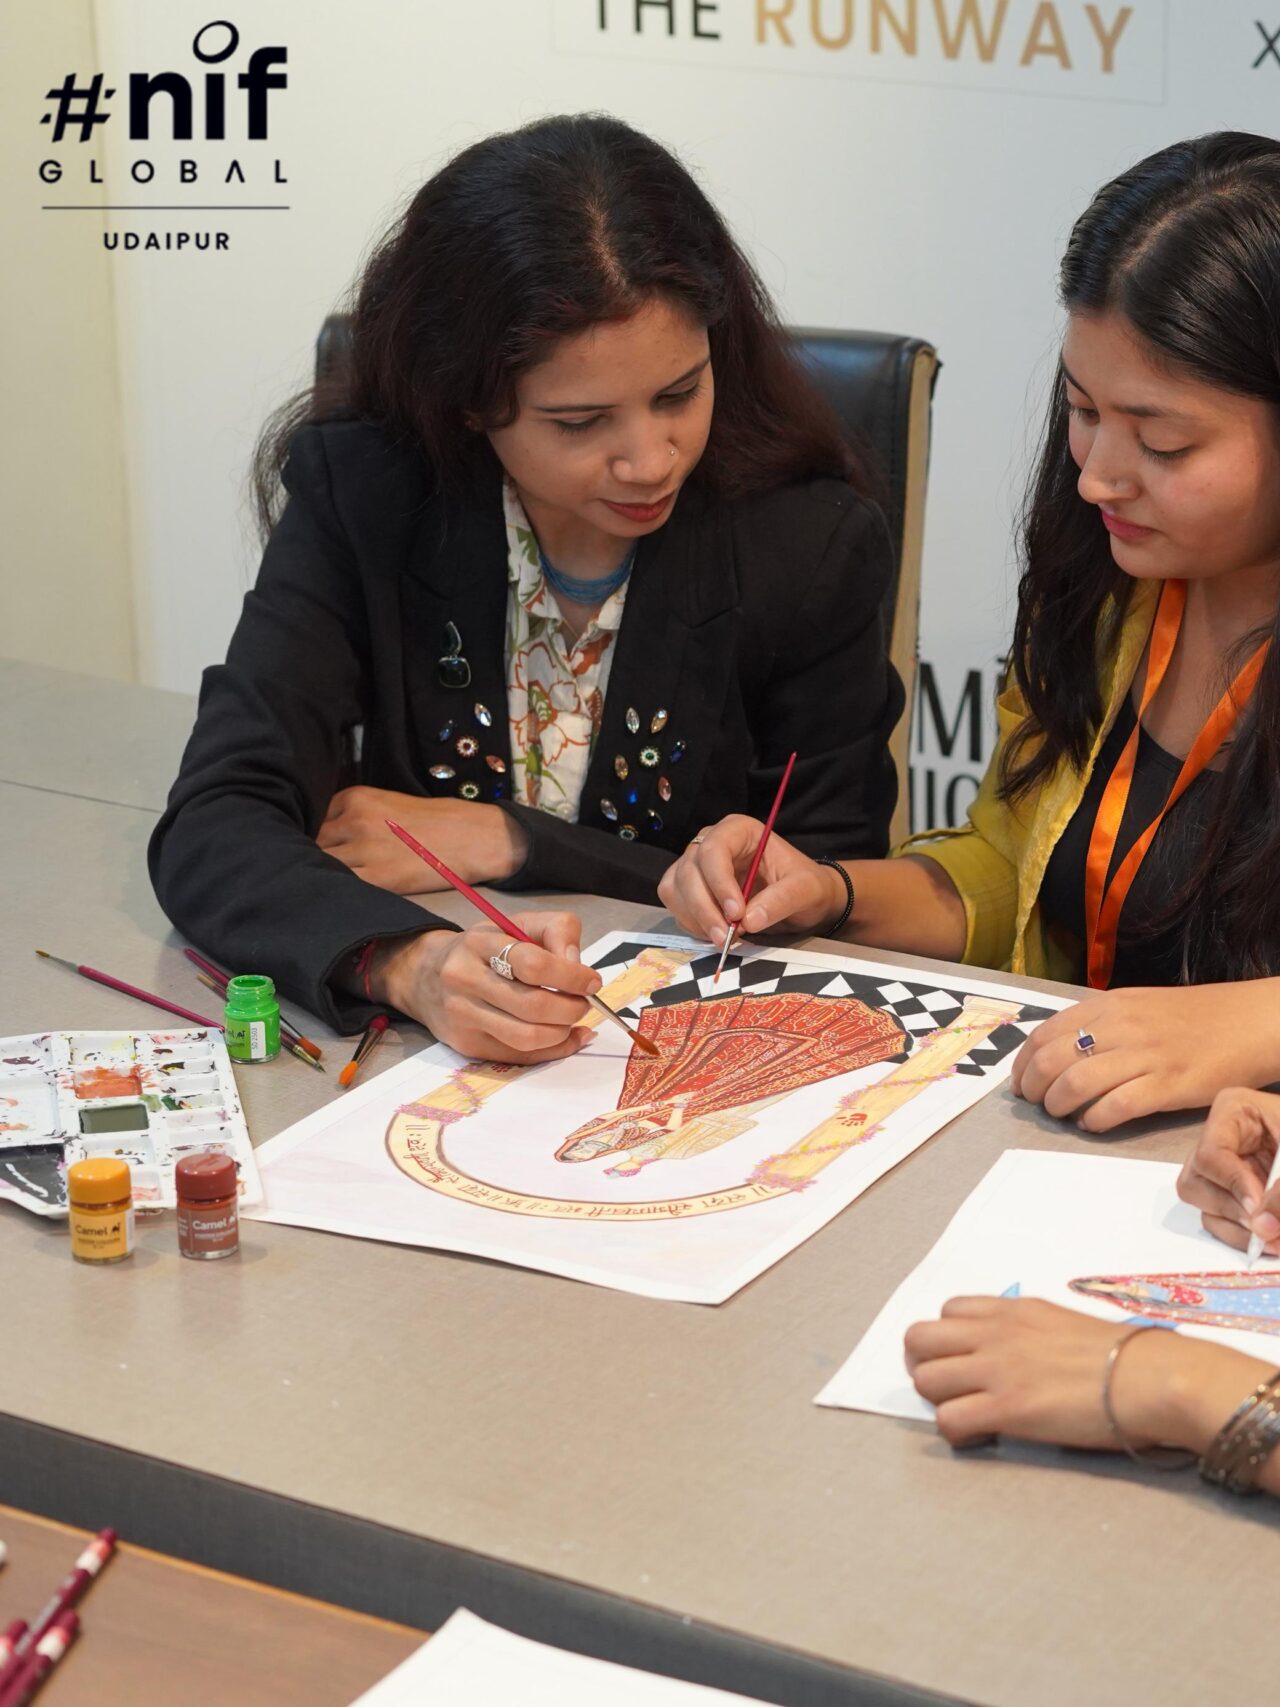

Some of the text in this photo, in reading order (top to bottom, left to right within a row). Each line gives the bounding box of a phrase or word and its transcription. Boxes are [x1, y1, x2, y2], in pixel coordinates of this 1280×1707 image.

[757, 0, 1134, 75] RUNWAY
[75, 1224, 108, 1236] Camel
[192, 1217, 227, 1231] Camel
